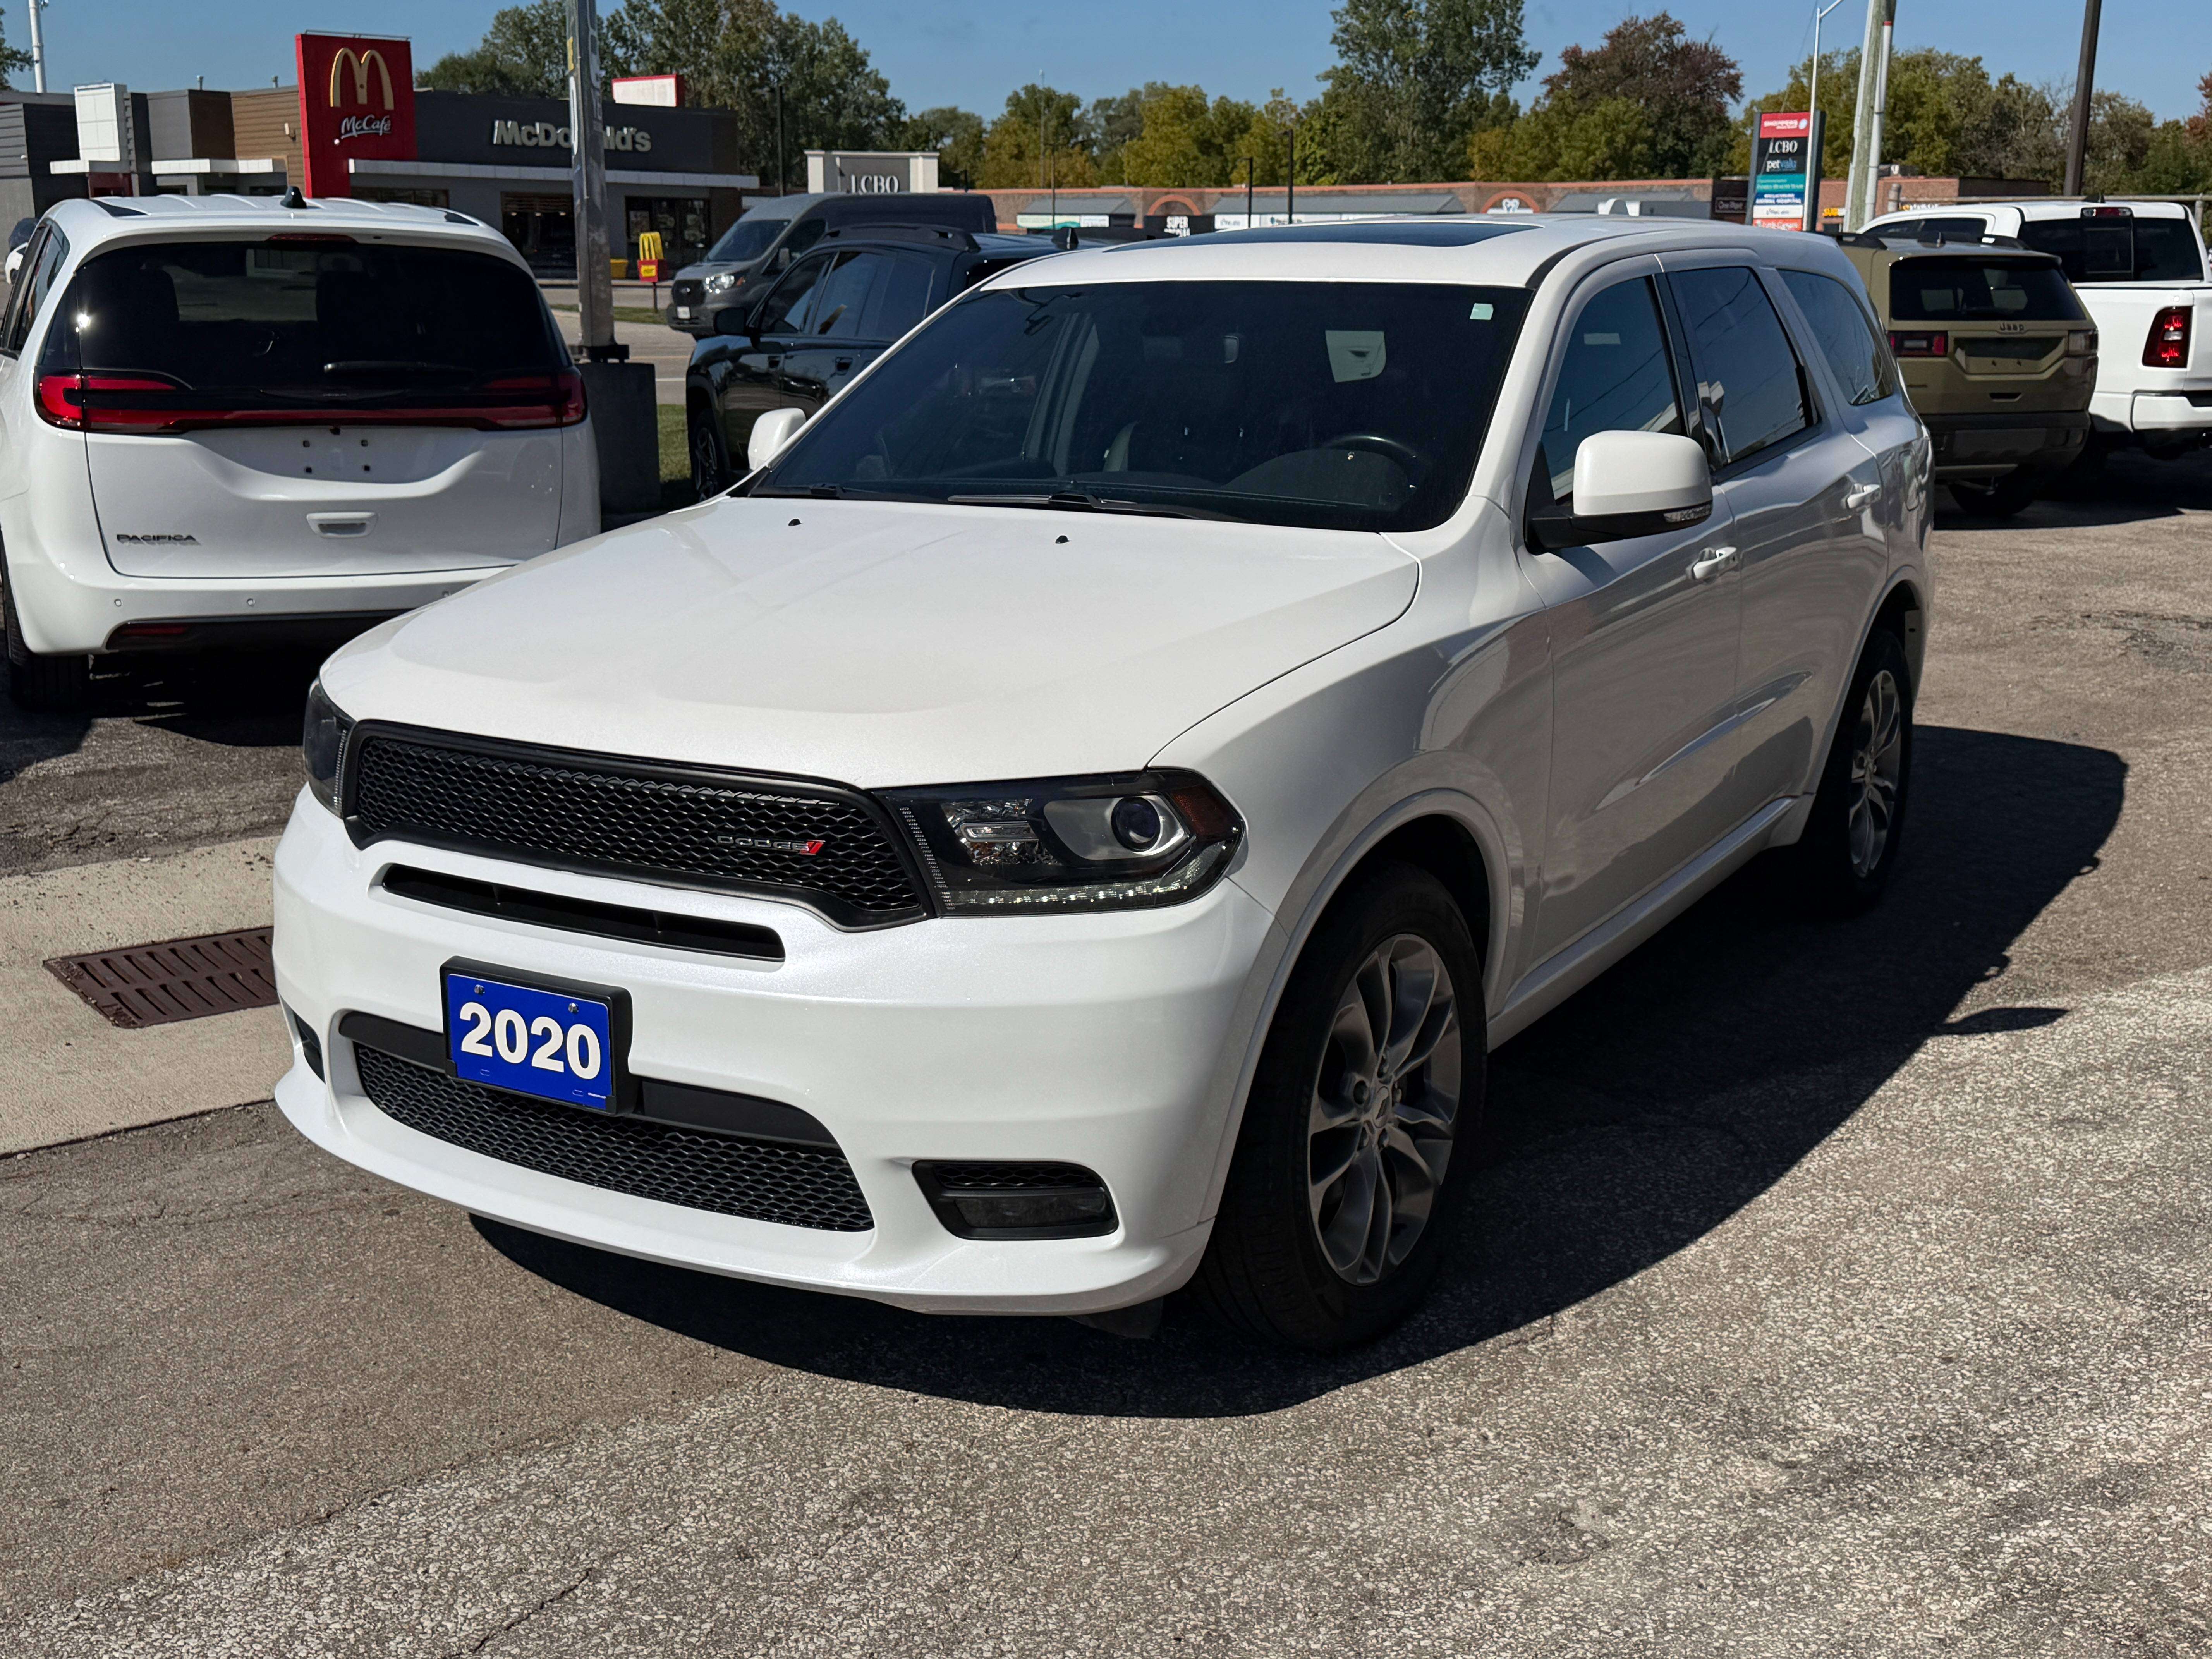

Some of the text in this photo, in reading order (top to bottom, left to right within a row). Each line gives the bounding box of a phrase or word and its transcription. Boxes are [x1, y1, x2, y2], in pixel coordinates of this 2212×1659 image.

[341, 113, 392, 138] McCafé
[493, 120, 652, 152] McDold's
[1769, 140, 1798, 153] LCBO
[851, 175, 899, 195] LCBO
[717, 835, 809, 852] DODGE
[459, 1001, 601, 1080] 2020
